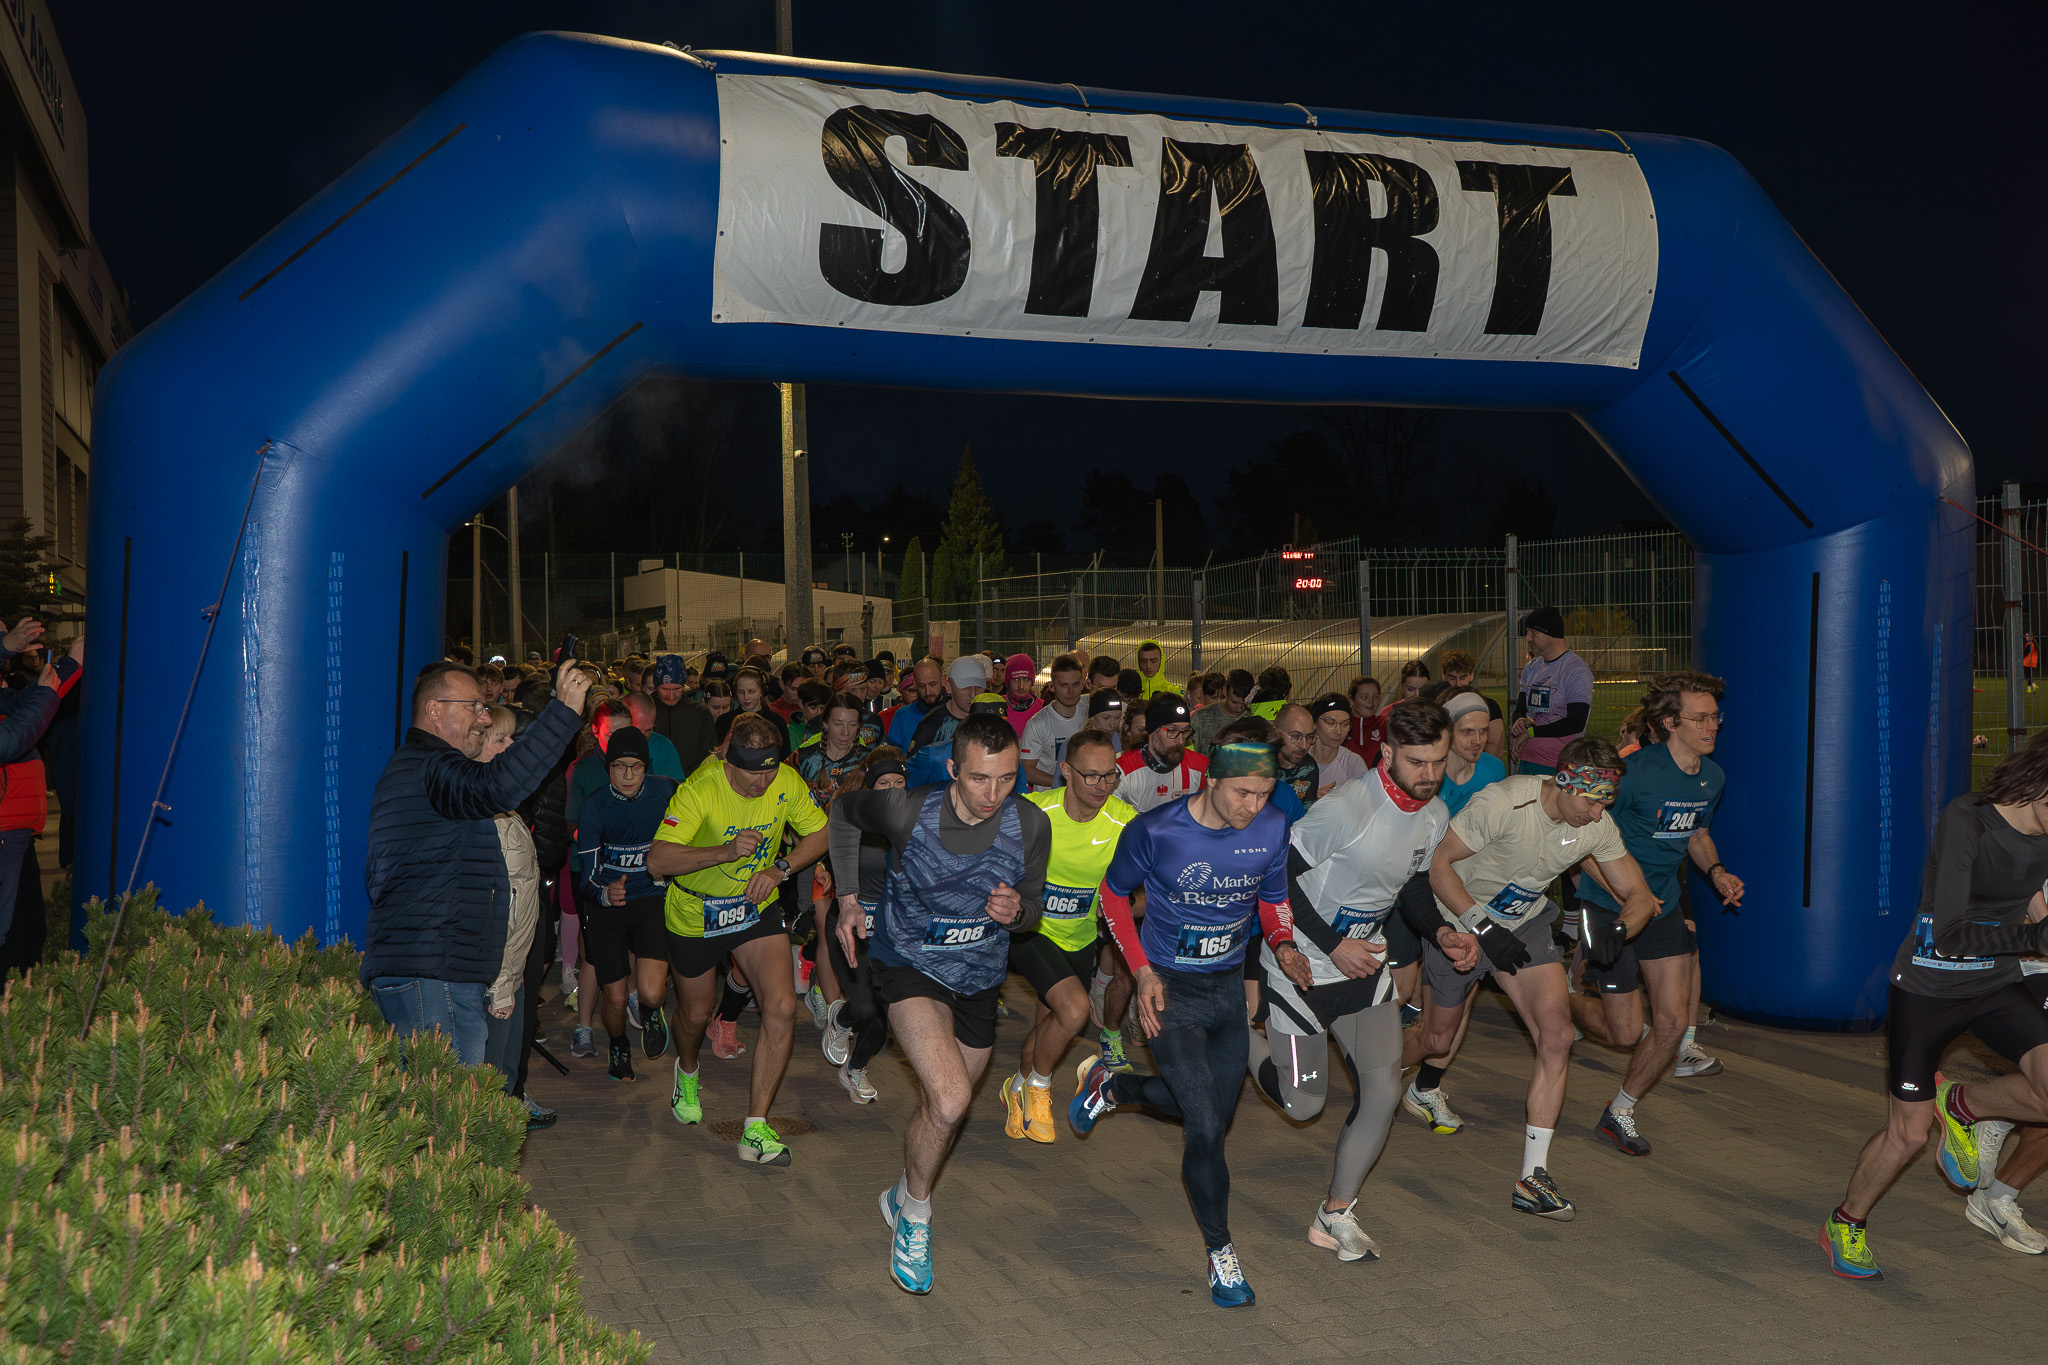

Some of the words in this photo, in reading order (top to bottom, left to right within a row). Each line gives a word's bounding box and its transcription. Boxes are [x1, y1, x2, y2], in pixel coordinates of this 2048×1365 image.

[819, 105, 1577, 334] START
[1296, 578, 1322, 588] 20:00
[1669, 813, 1696, 830] 244
[620, 853, 643, 866] 174
[1046, 895, 1079, 913] 066
[719, 905, 745, 927] 099
[944, 926, 985, 944] 208
[1347, 922, 1375, 939] 109
[1200, 934, 1231, 956] 165
